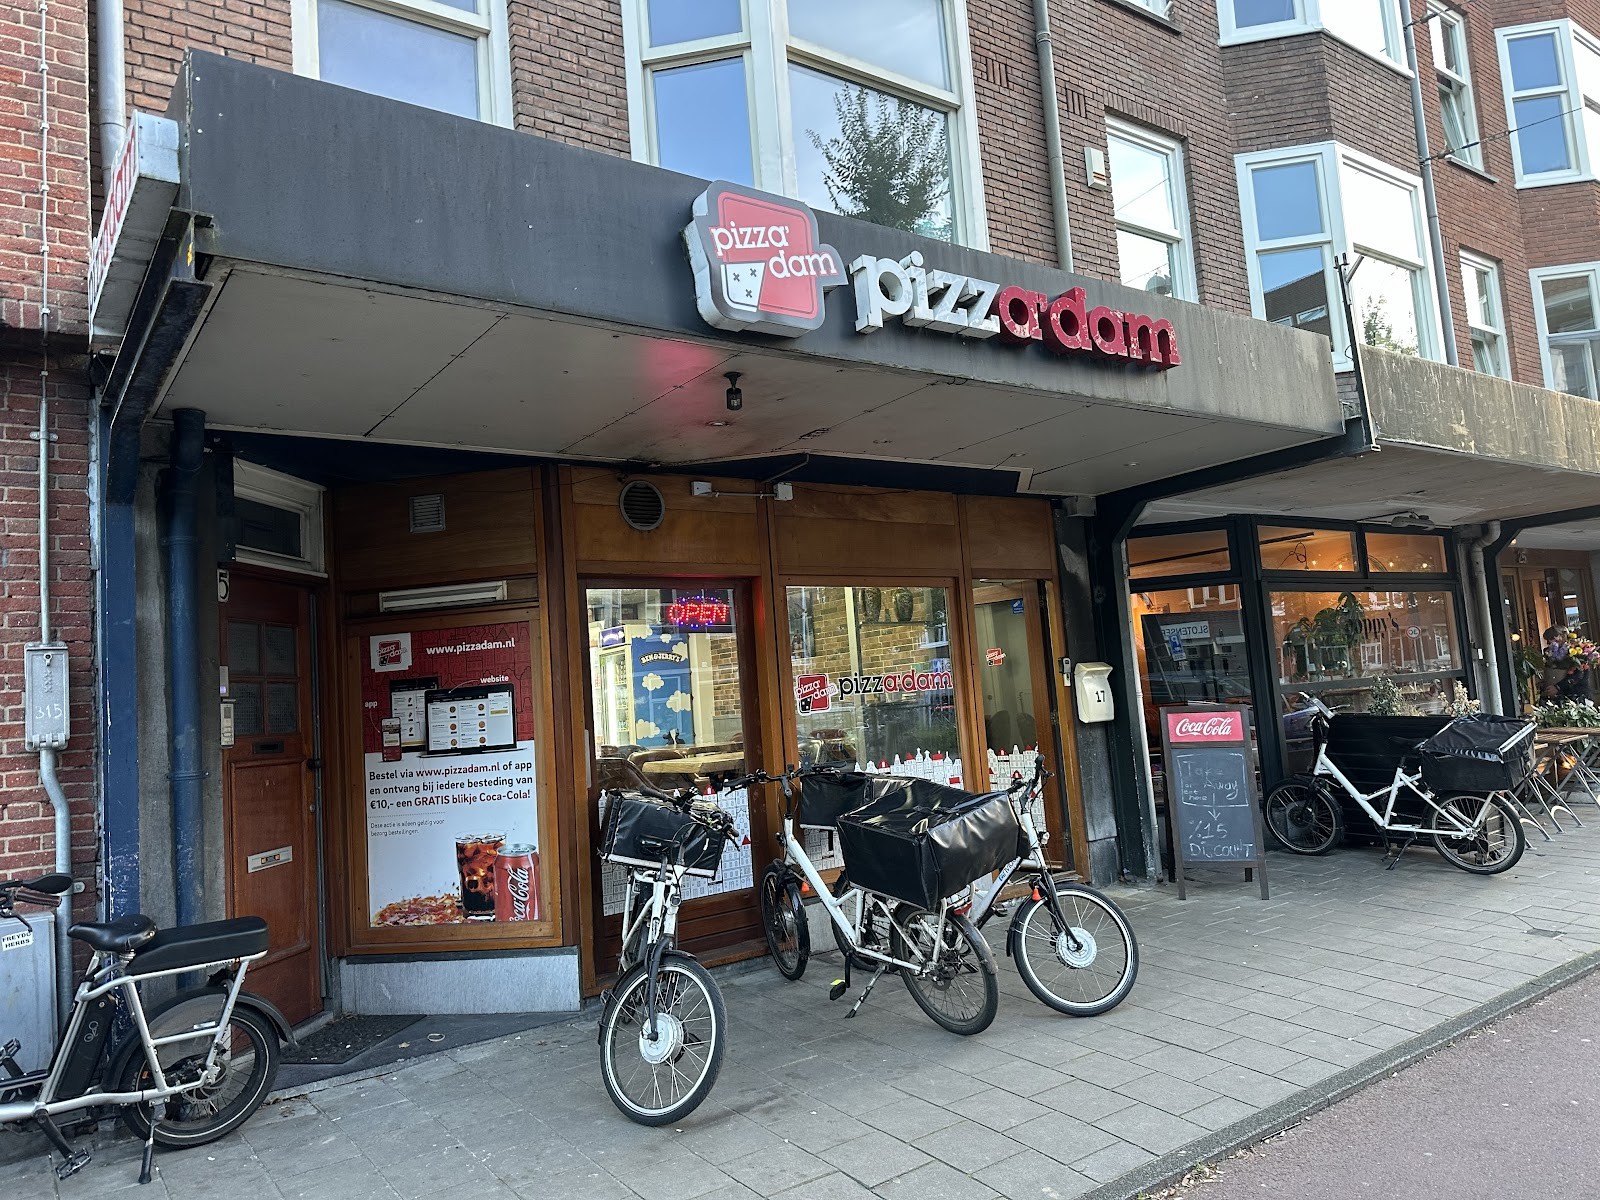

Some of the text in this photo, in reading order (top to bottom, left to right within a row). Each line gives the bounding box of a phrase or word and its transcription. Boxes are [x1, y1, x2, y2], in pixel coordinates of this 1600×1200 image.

[768, 250, 839, 279] dam
[668, 603, 728, 622] OPEN
[426, 638, 515, 655] www.pizzadam.nl
[480, 674, 509, 684] website
[813, 682, 837, 699] dam
[1095, 690, 1106, 703] 17
[36, 704, 63, 718] 315
[364, 701, 378, 709] app
[1175, 717, 1234, 737] Coca-Cola
[369, 761, 532, 781] Bestel via www.pizzadam.nl of app
[369, 776, 533, 795] en ontvang bij iedere besteding van
[370, 789, 531, 810] €10,- een GRATIS blikje Coca-Cola!
[5, 939, 30, 949] HERBS
